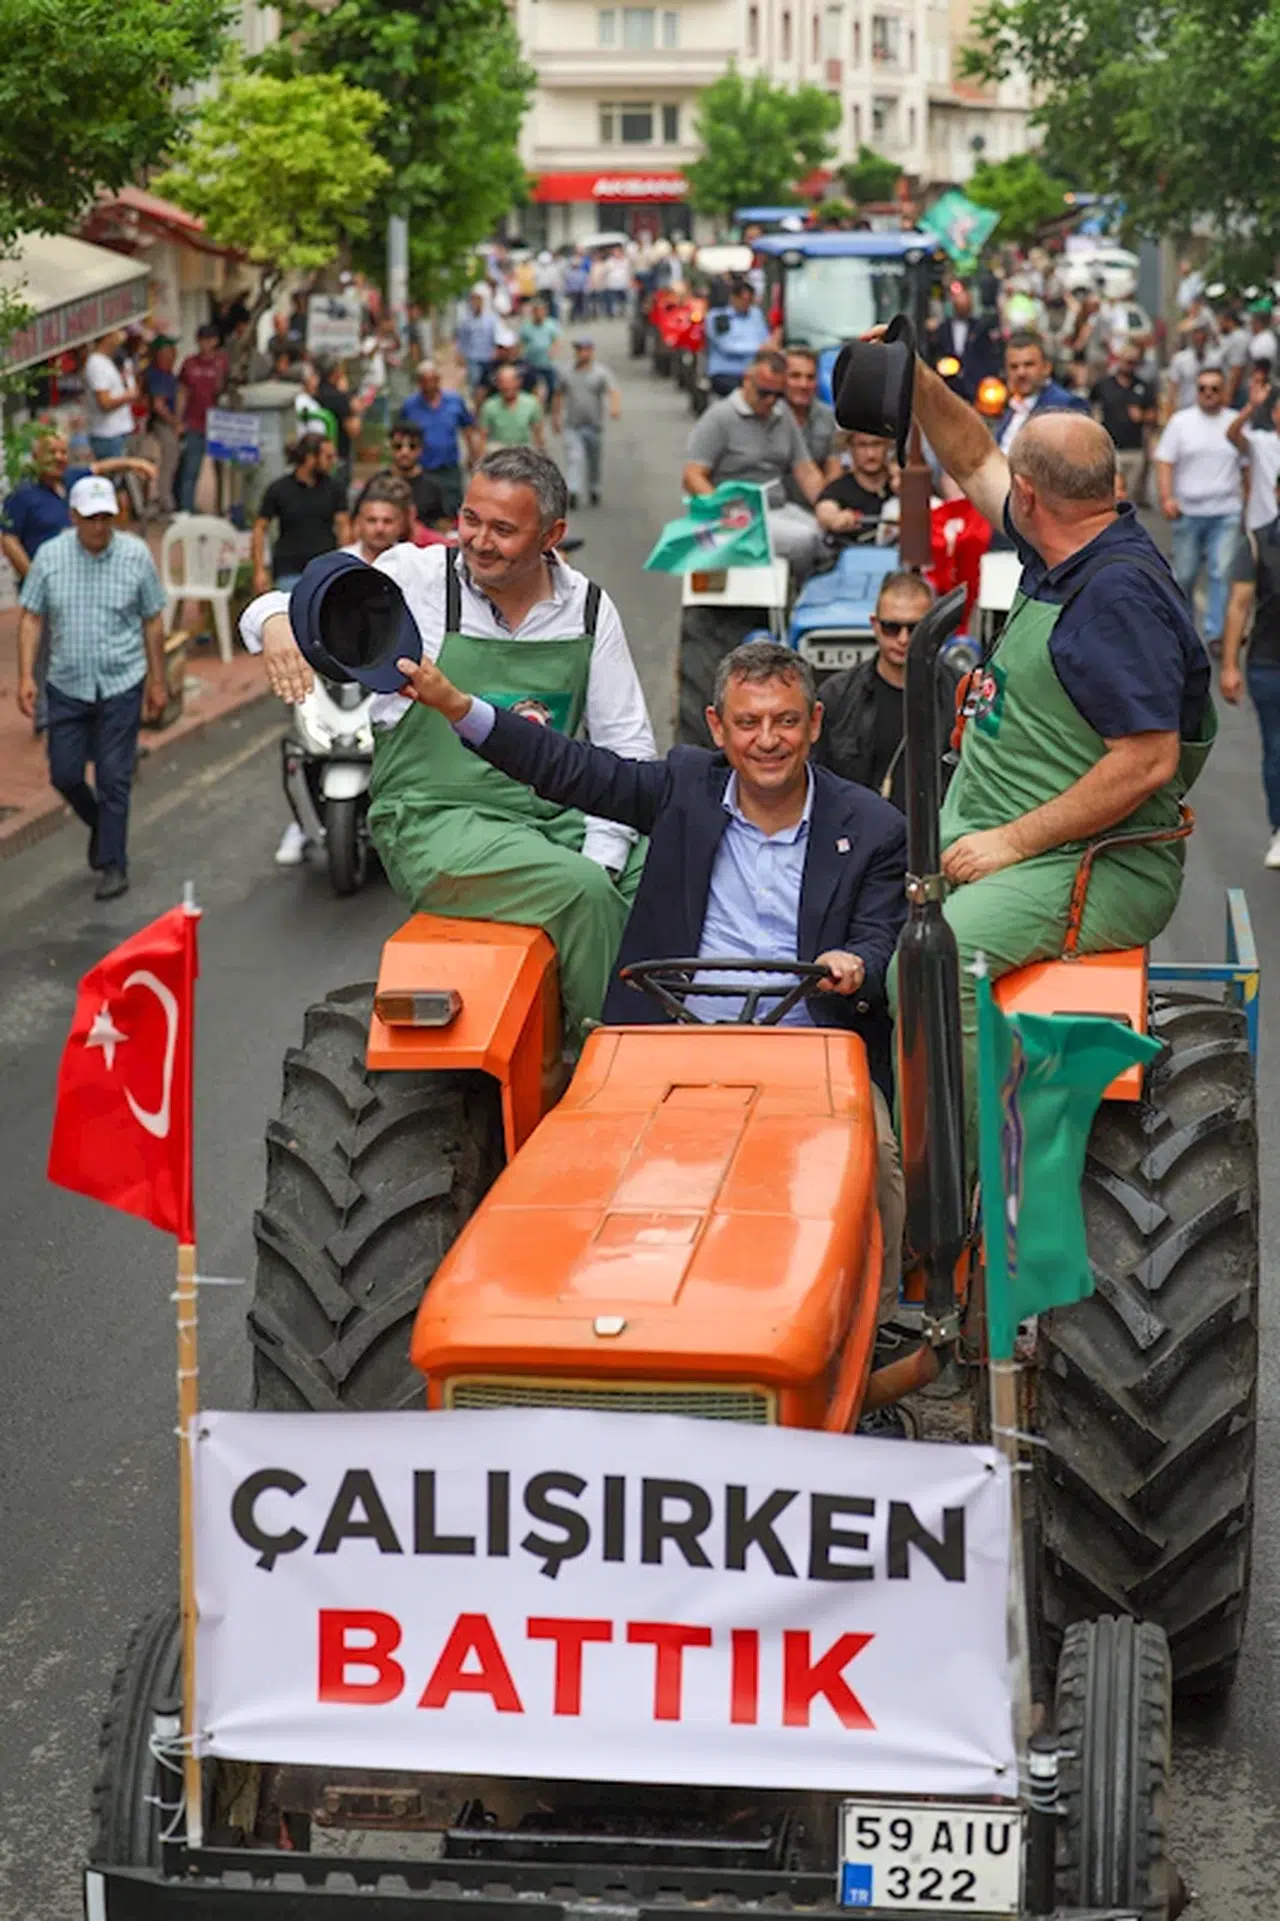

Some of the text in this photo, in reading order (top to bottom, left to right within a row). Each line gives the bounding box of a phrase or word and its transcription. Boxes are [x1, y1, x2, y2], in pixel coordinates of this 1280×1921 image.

[230, 1468, 967, 1583] ÇALIŞIRKEN
[317, 1608, 877, 1730] BATTIK
[857, 1817, 1010, 1856] 59 AIU
[850, 1888, 870, 1903] TR
[887, 1866, 977, 1903] 322
